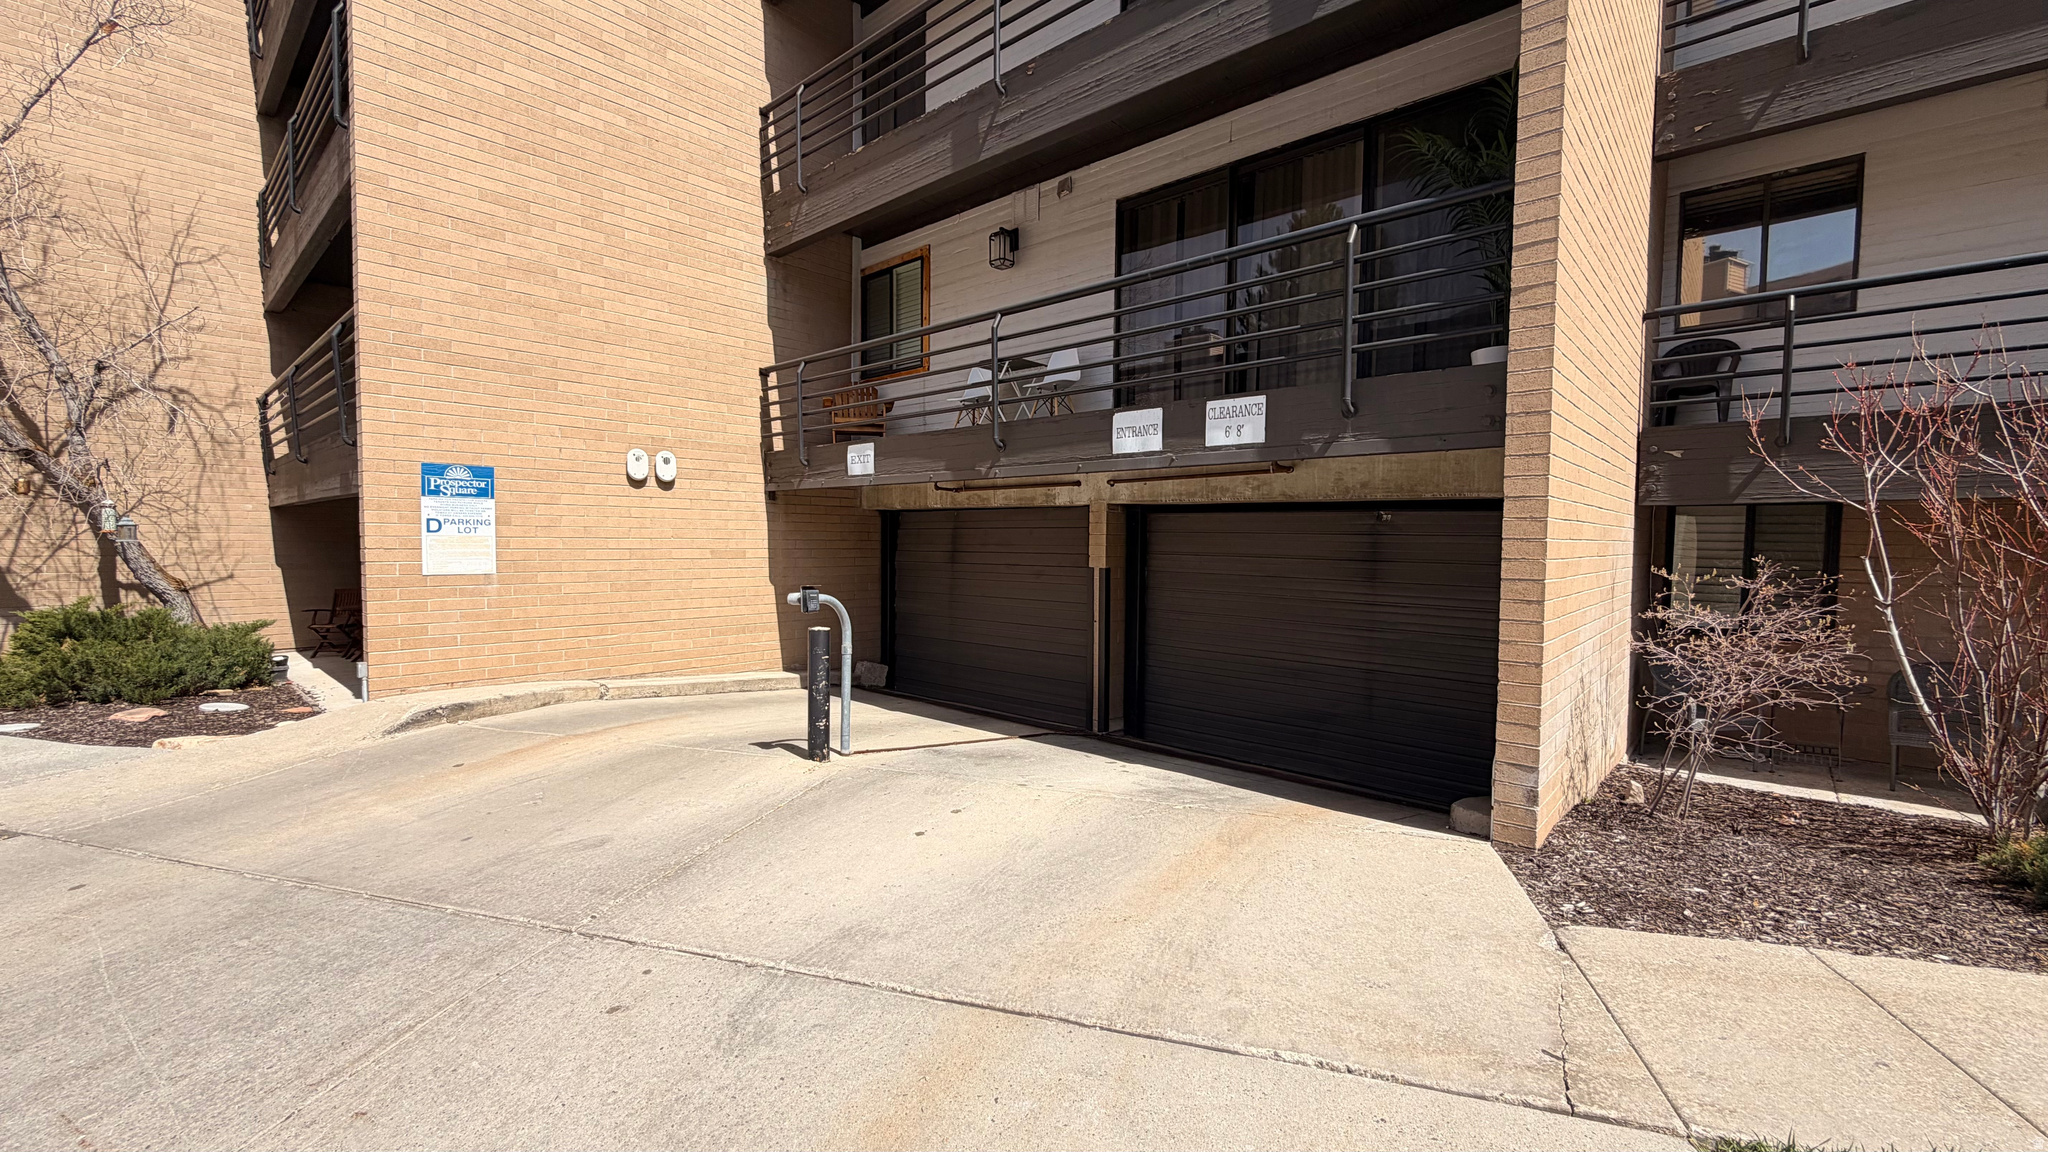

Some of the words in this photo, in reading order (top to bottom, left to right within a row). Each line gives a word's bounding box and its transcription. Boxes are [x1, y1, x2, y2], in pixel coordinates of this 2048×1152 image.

[1208, 402, 1264, 421] CLEARANCE
[1116, 423, 1159, 439] ENTRANCE
[850, 453, 871, 465] EXIT
[428, 477, 487, 490] Prospector
[440, 485, 478, 497] Square
[426, 518, 443, 533] D
[443, 518, 491, 526] PARKING
[457, 526, 479, 534] LOT
